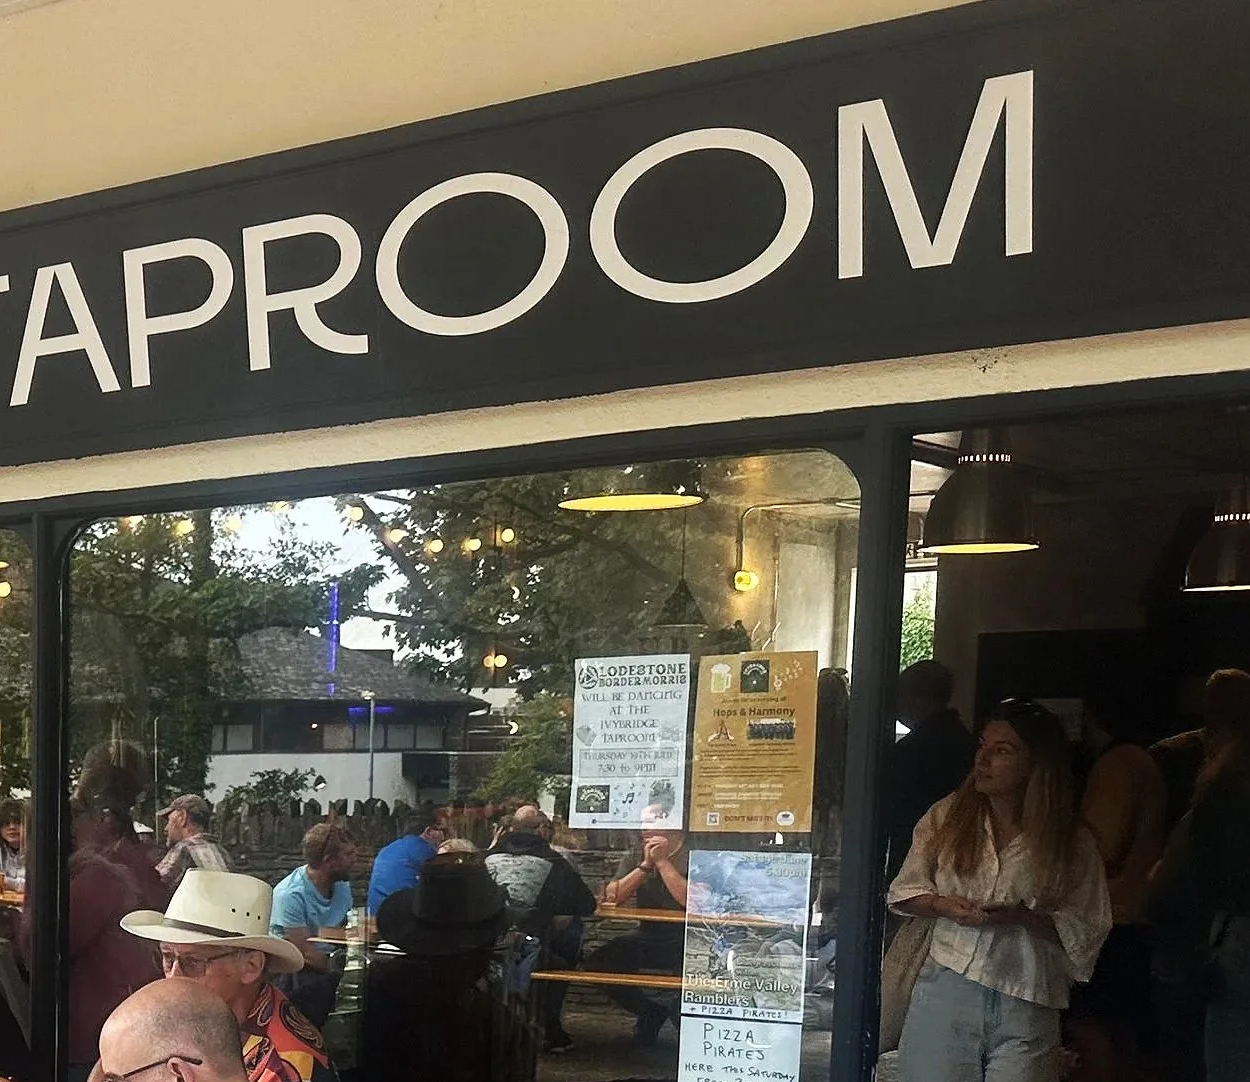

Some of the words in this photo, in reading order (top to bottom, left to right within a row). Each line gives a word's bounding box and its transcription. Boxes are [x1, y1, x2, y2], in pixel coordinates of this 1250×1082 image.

[599, 663, 687, 677] LODESTONE
[581, 692, 607, 702] WILL
[612, 692, 625, 701] BE
[628, 690, 682, 701] DANCING
[610, 705, 623, 715] AT
[629, 705, 650, 715] THE
[713, 708, 737, 719] Hops
[739, 708, 747, 716] &
[748, 707, 796, 718] Harmony
[600, 719, 659, 729] IVYBRIDGE
[602, 733, 656, 743] TAPROOM
[685, 973, 710, 986] The
[715, 975, 751, 990] Erme
[755, 978, 799, 995] Valley
[683, 990, 750, 1007] Ramblers
[701, 1005, 733, 1015] PIZZA
[703, 1022, 754, 1043] PIZZA
[703, 1041, 765, 1060] PIRATES
[685, 1063, 714, 1073] HERE
